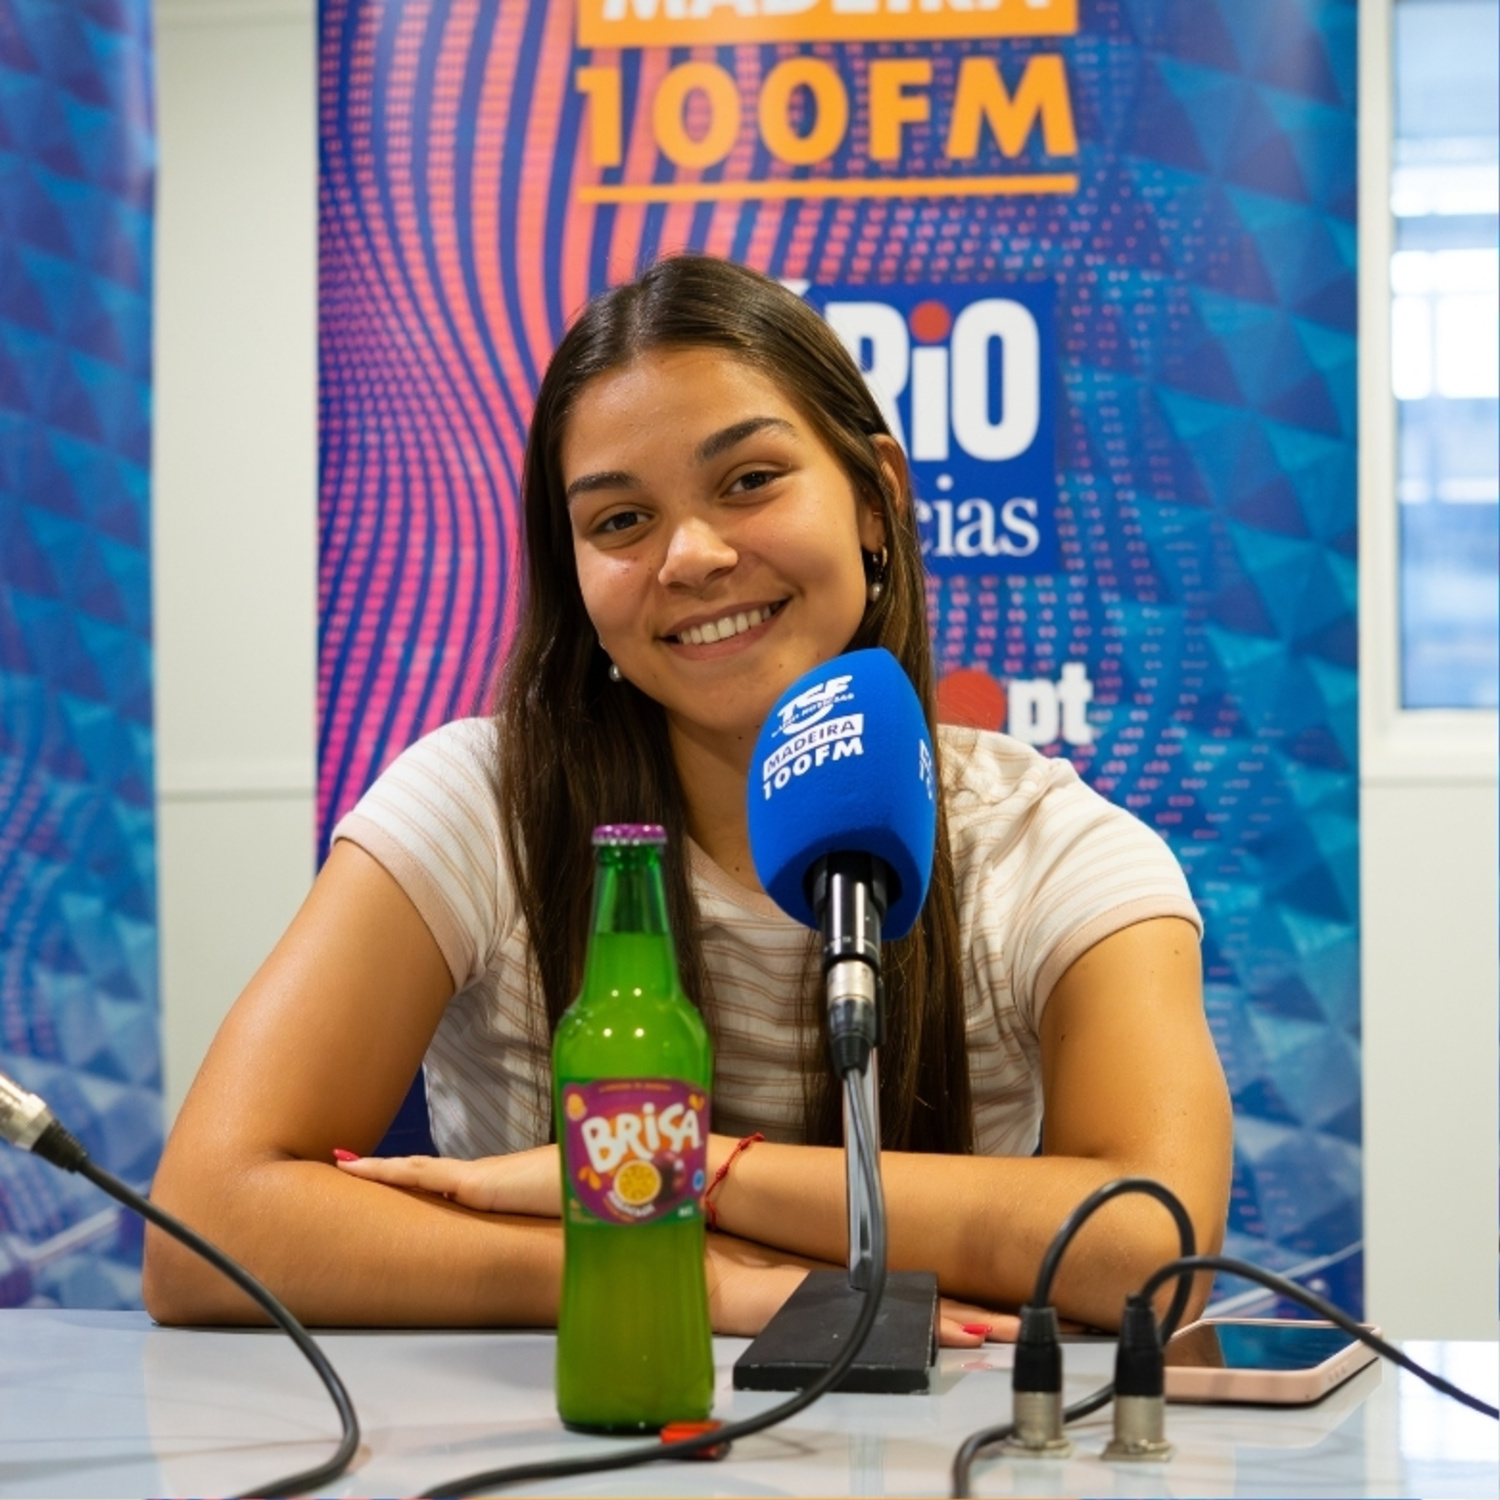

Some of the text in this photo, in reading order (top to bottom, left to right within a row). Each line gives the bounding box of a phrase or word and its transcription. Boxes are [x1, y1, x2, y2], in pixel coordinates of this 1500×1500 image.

[577, 54, 1077, 168] 100FM
[762, 737, 864, 801] 100FM
[766, 719, 856, 774] MADEIRA
